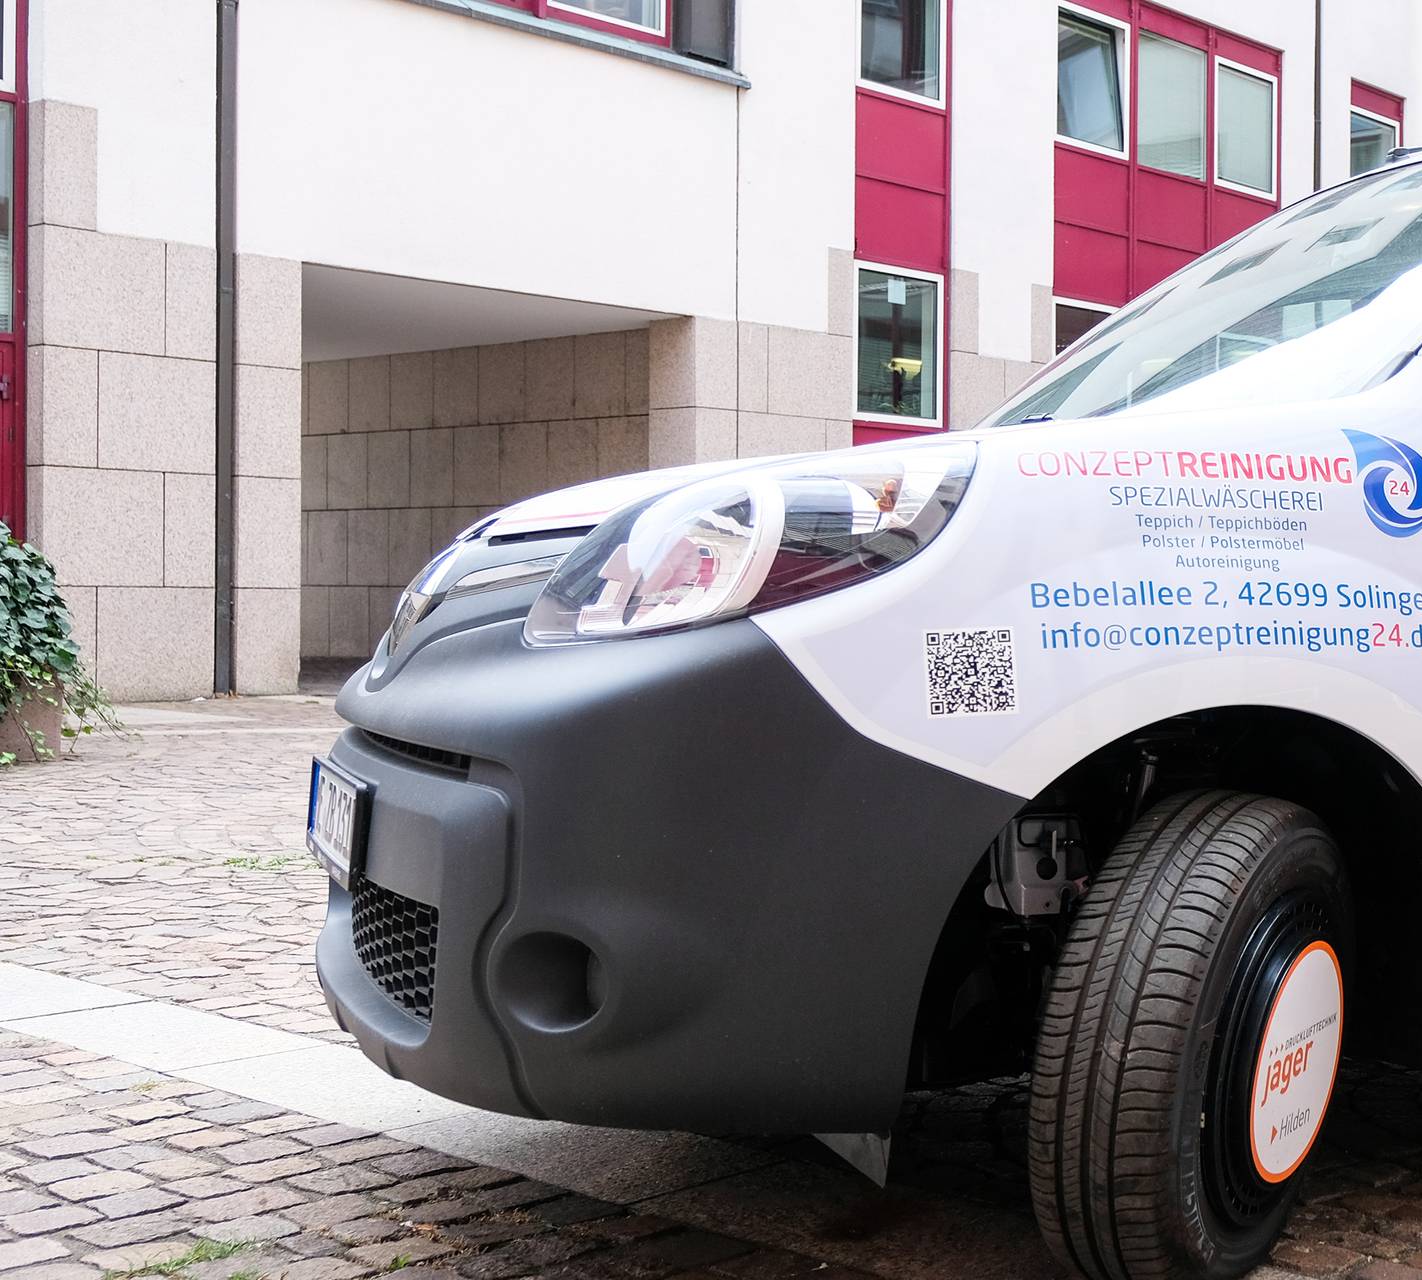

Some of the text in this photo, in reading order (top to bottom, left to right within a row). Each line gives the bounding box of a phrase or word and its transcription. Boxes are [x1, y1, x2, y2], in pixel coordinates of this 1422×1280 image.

[1017, 450, 1353, 485] CONZEPTREINIGUNG
[1109, 484, 1324, 512] SPEZIALWÄSCHEREI
[1389, 480, 1410, 496] 24
[1135, 514, 1308, 533] Teppich / Teppichböden
[1142, 534, 1305, 552] Polster / Polstermöbel
[1176, 554, 1280, 573] Autoreinigung
[1030, 582, 1192, 609] Bebelallee
[1203, 581, 1228, 609] 2,
[1238, 582, 1328, 607] 42699
[1285, 1012, 1338, 1050] DRUCKLUFTTECHNIK
[1279, 1108, 1311, 1140] Hilden
